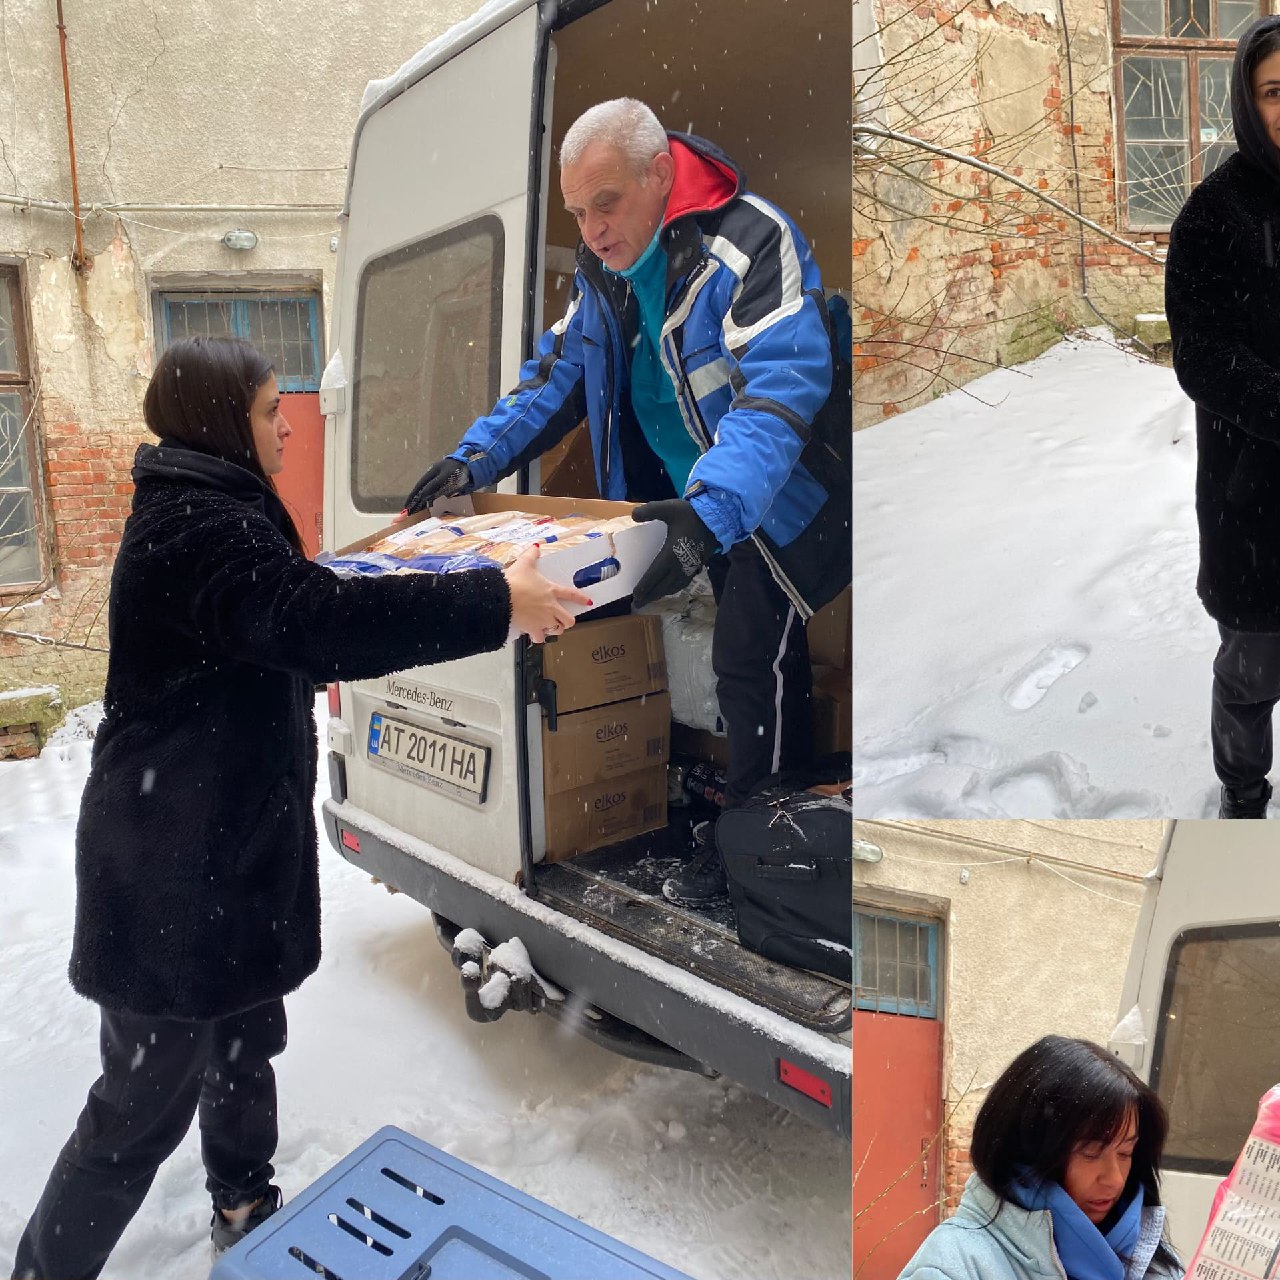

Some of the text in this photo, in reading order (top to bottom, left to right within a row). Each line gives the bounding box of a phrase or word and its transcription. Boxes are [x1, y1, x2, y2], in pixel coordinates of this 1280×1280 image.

[592, 643, 626, 663] elkos
[385, 680, 454, 712] Mercedes-Benz
[596, 721, 629, 742] elkos
[381, 724, 476, 783] AT 2011 HA
[594, 790, 626, 811] elkos
